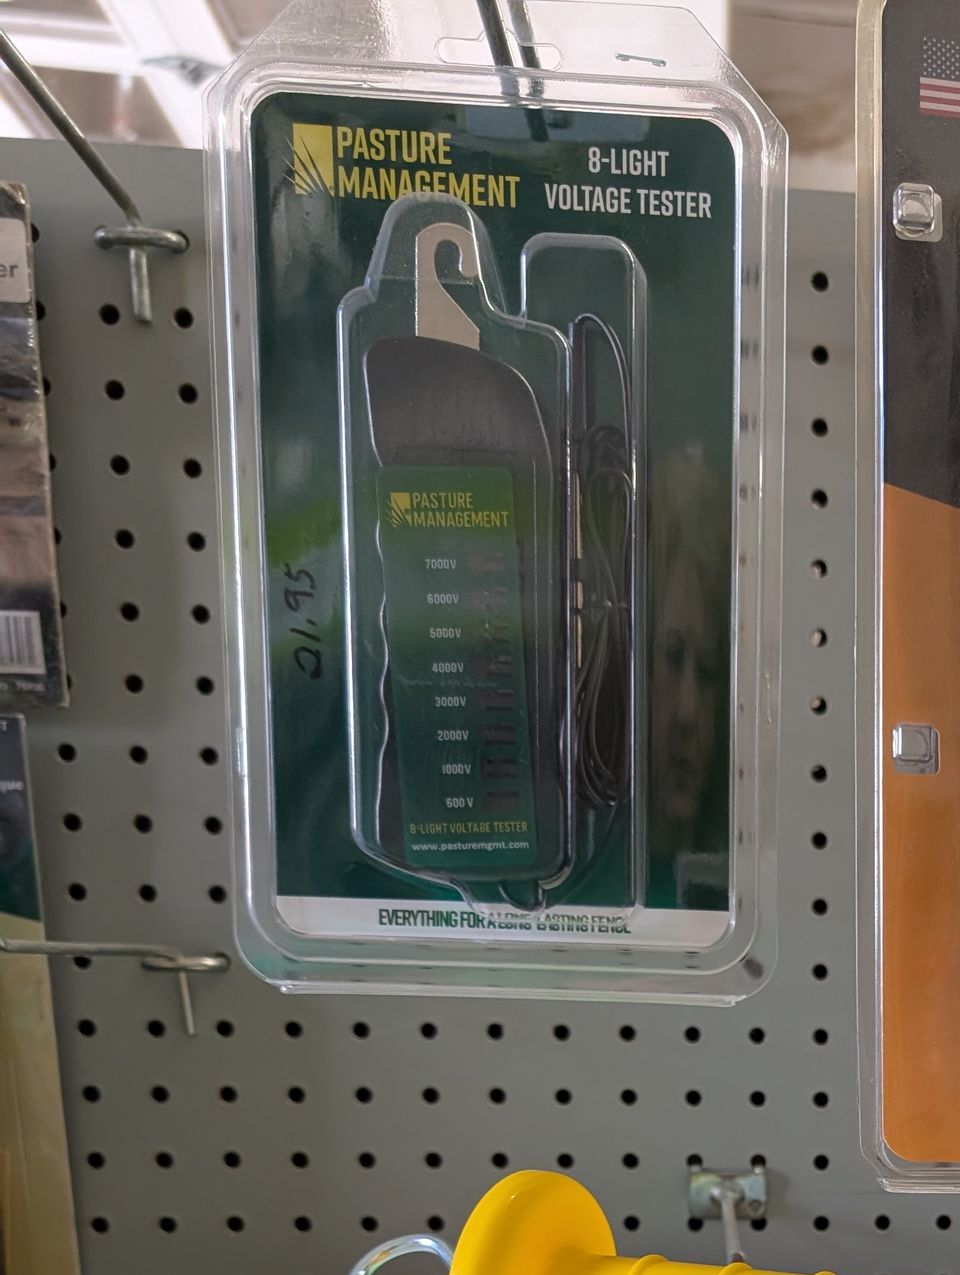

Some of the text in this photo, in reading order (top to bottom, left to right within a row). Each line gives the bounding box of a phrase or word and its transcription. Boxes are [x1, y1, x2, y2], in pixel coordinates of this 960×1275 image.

[336, 126, 451, 164] PASTURE
[588, 146, 669, 177] 8-LIGHT
[338, 165, 520, 210] MANAGEMENT
[544, 183, 711, 218] VOLTAGE TESTER
[412, 492, 473, 513] PASTURE
[413, 511, 509, 527] MANAGEMENT
[425, 558, 456, 569] 7000V
[427, 593, 459, 604] 6000V
[429, 627, 461, 638] 5000V
[432, 662, 464, 673] 4000V
[435, 695, 466, 707] 3000V
[437, 729, 469, 741] 2000V
[442, 763, 471, 775] 1000V
[411, 841, 529, 851] www.pasturemgmt.com
[379, 908, 458, 928] EVERYTHING
[460, 911, 485, 929] FOR
